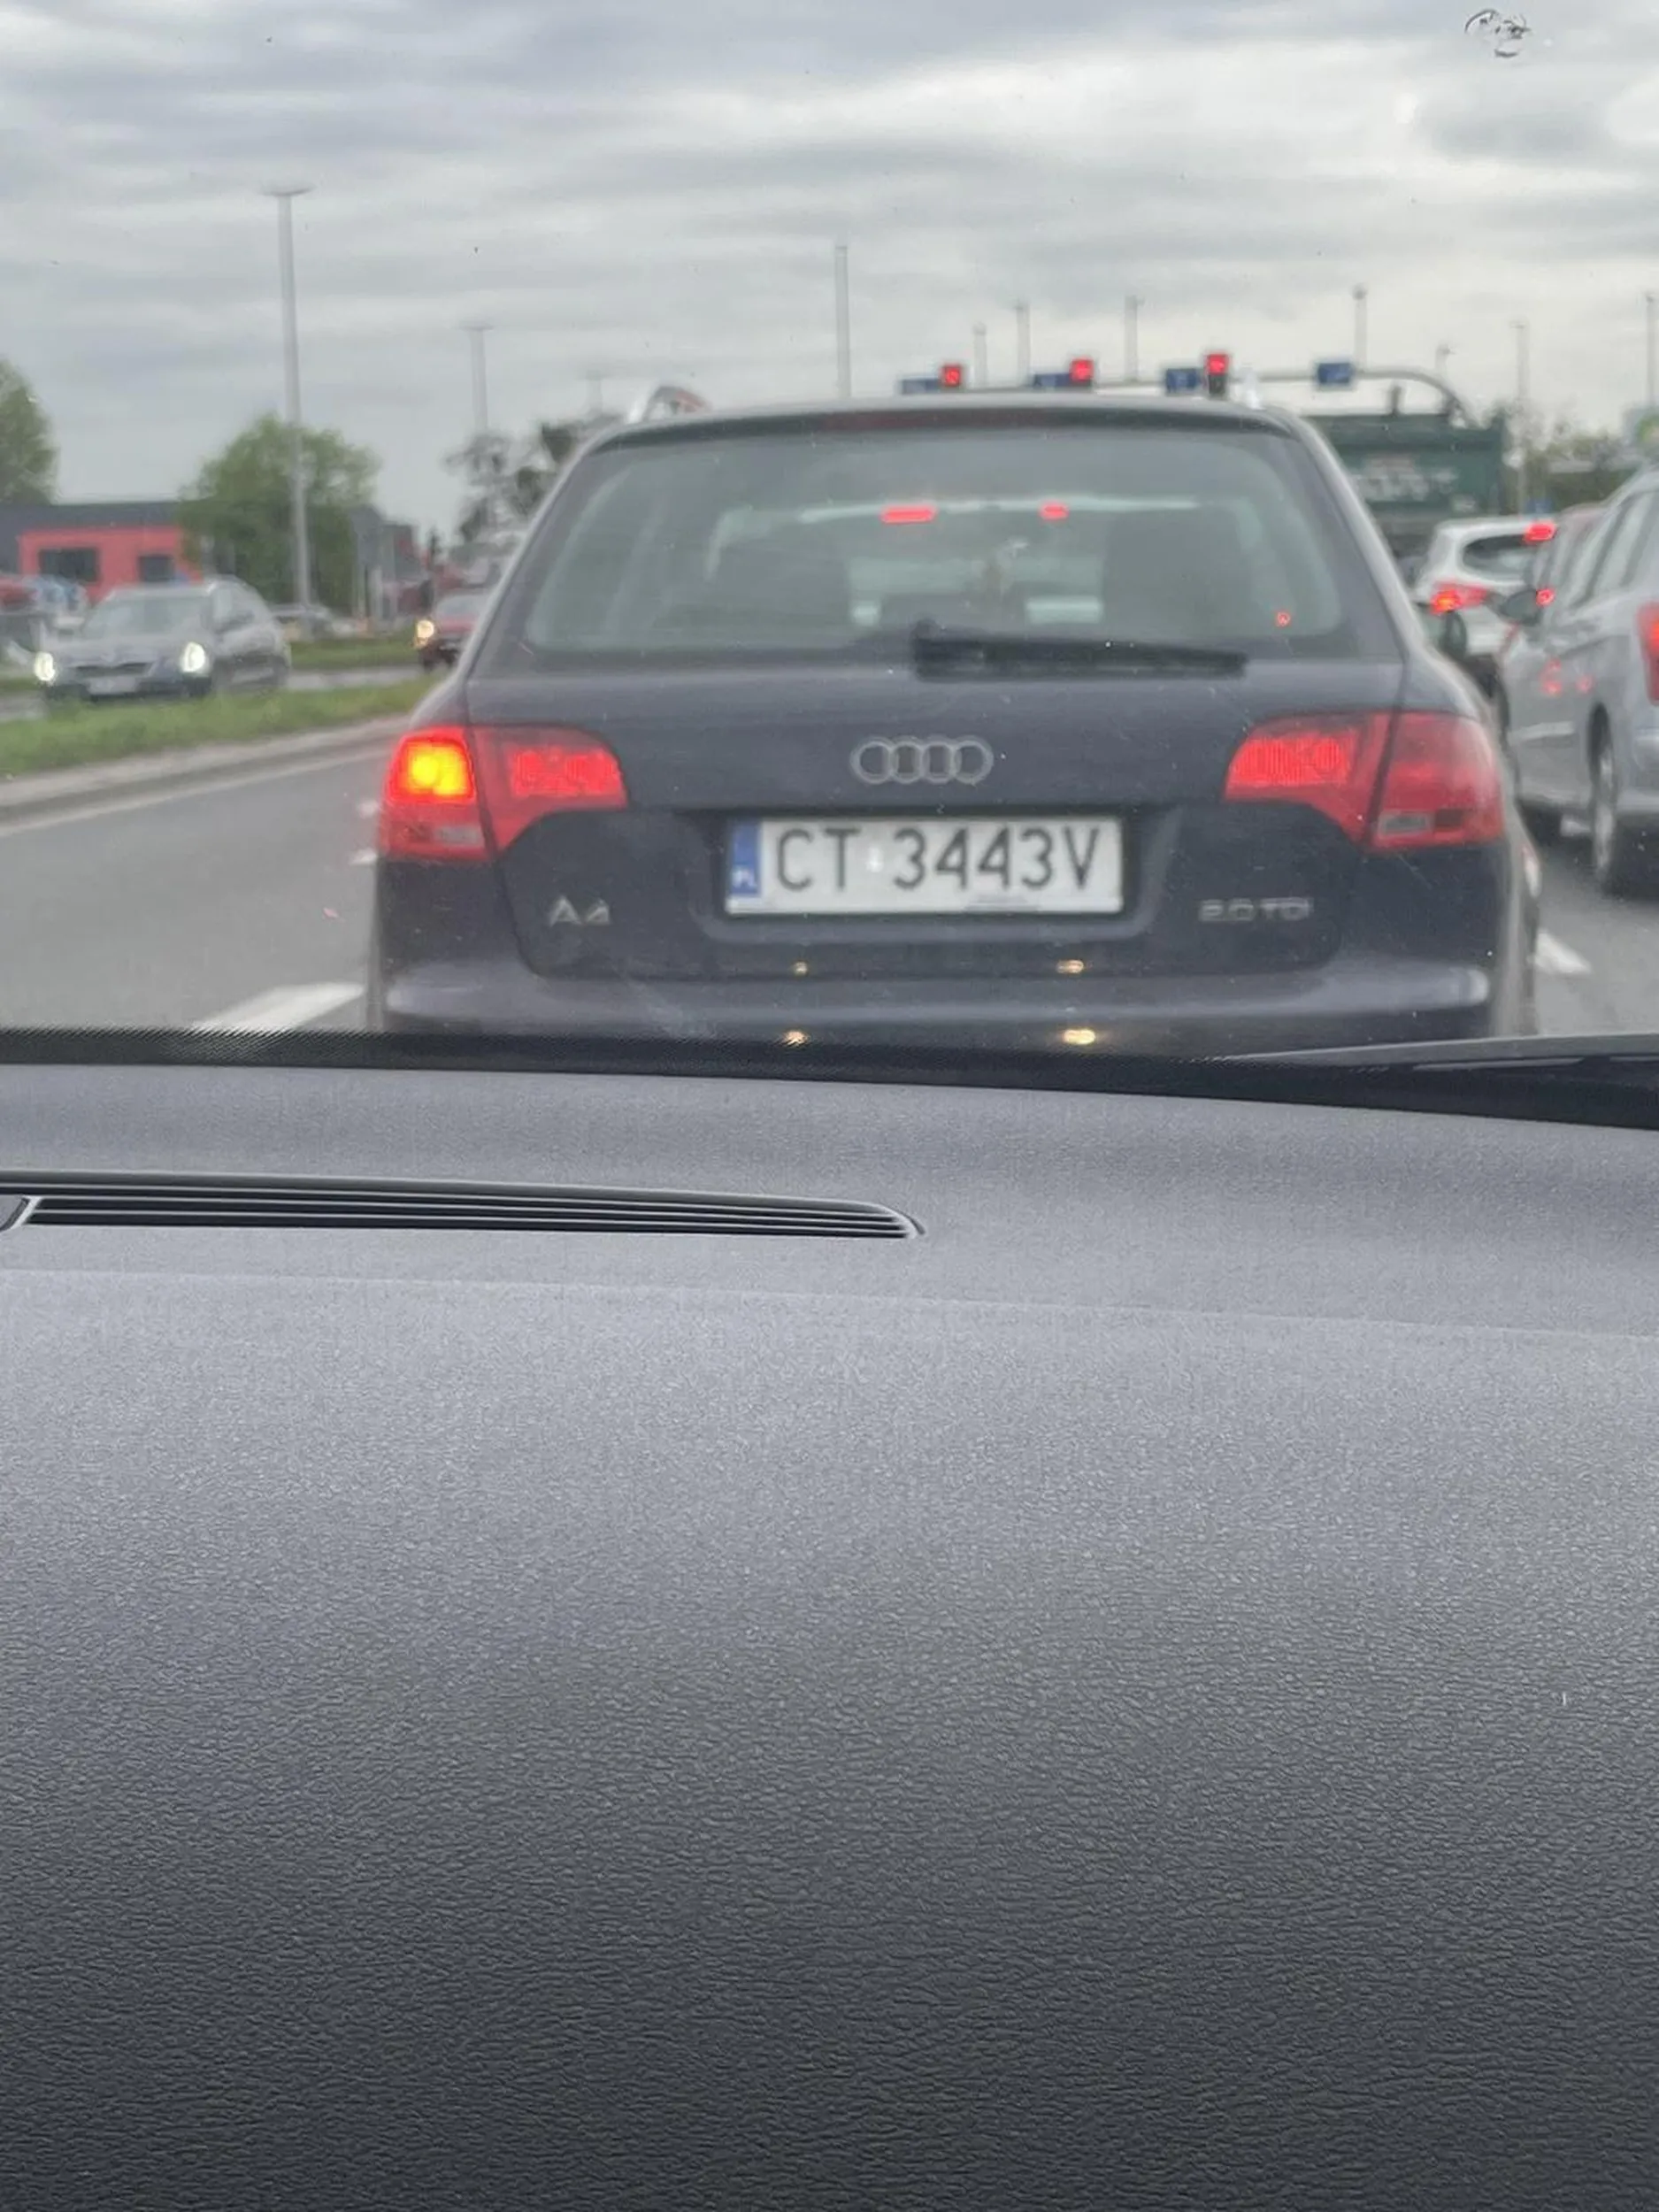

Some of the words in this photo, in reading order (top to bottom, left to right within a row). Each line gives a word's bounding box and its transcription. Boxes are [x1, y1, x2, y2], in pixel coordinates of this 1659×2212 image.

[777, 827, 860, 890] CT
[893, 827, 1100, 890] 3443V
[549, 895, 611, 927] A4
